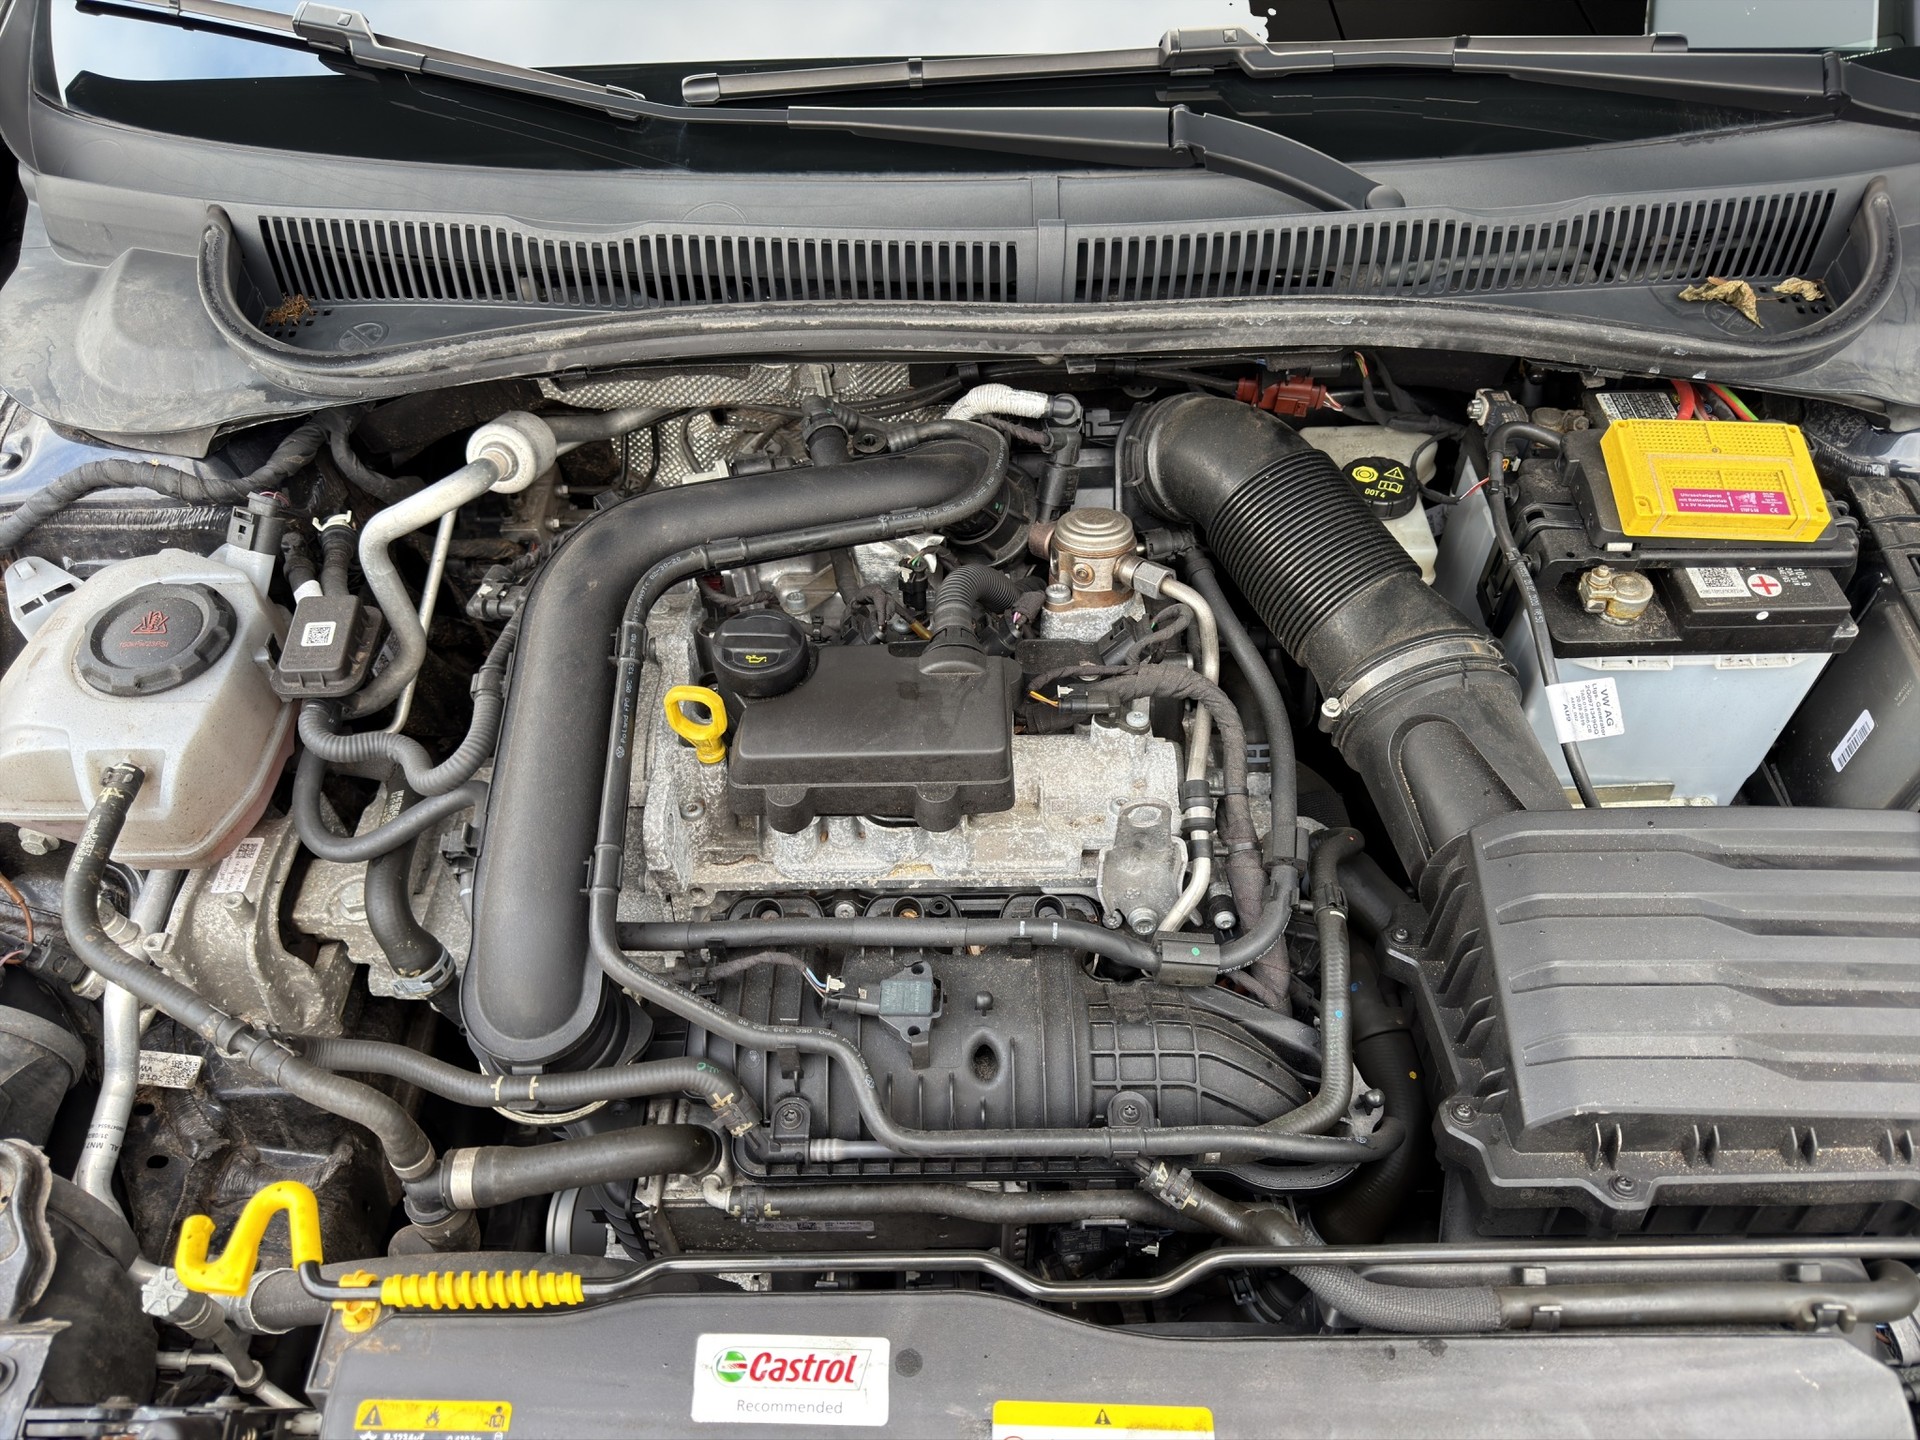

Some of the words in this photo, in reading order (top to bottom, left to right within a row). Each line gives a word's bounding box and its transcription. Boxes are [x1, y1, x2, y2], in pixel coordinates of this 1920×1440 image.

[1364, 488, 1380, 497] DOT
[1380, 491, 1387, 499] 4
[1600, 688, 1611, 707] VW
[1596, 701, 1606, 736] Generator
[1604, 710, 1614, 727] AG
[620, 715, 629, 744] Poland
[750, 1352, 857, 1383] Castrol
[737, 1400, 843, 1414] Recommended
